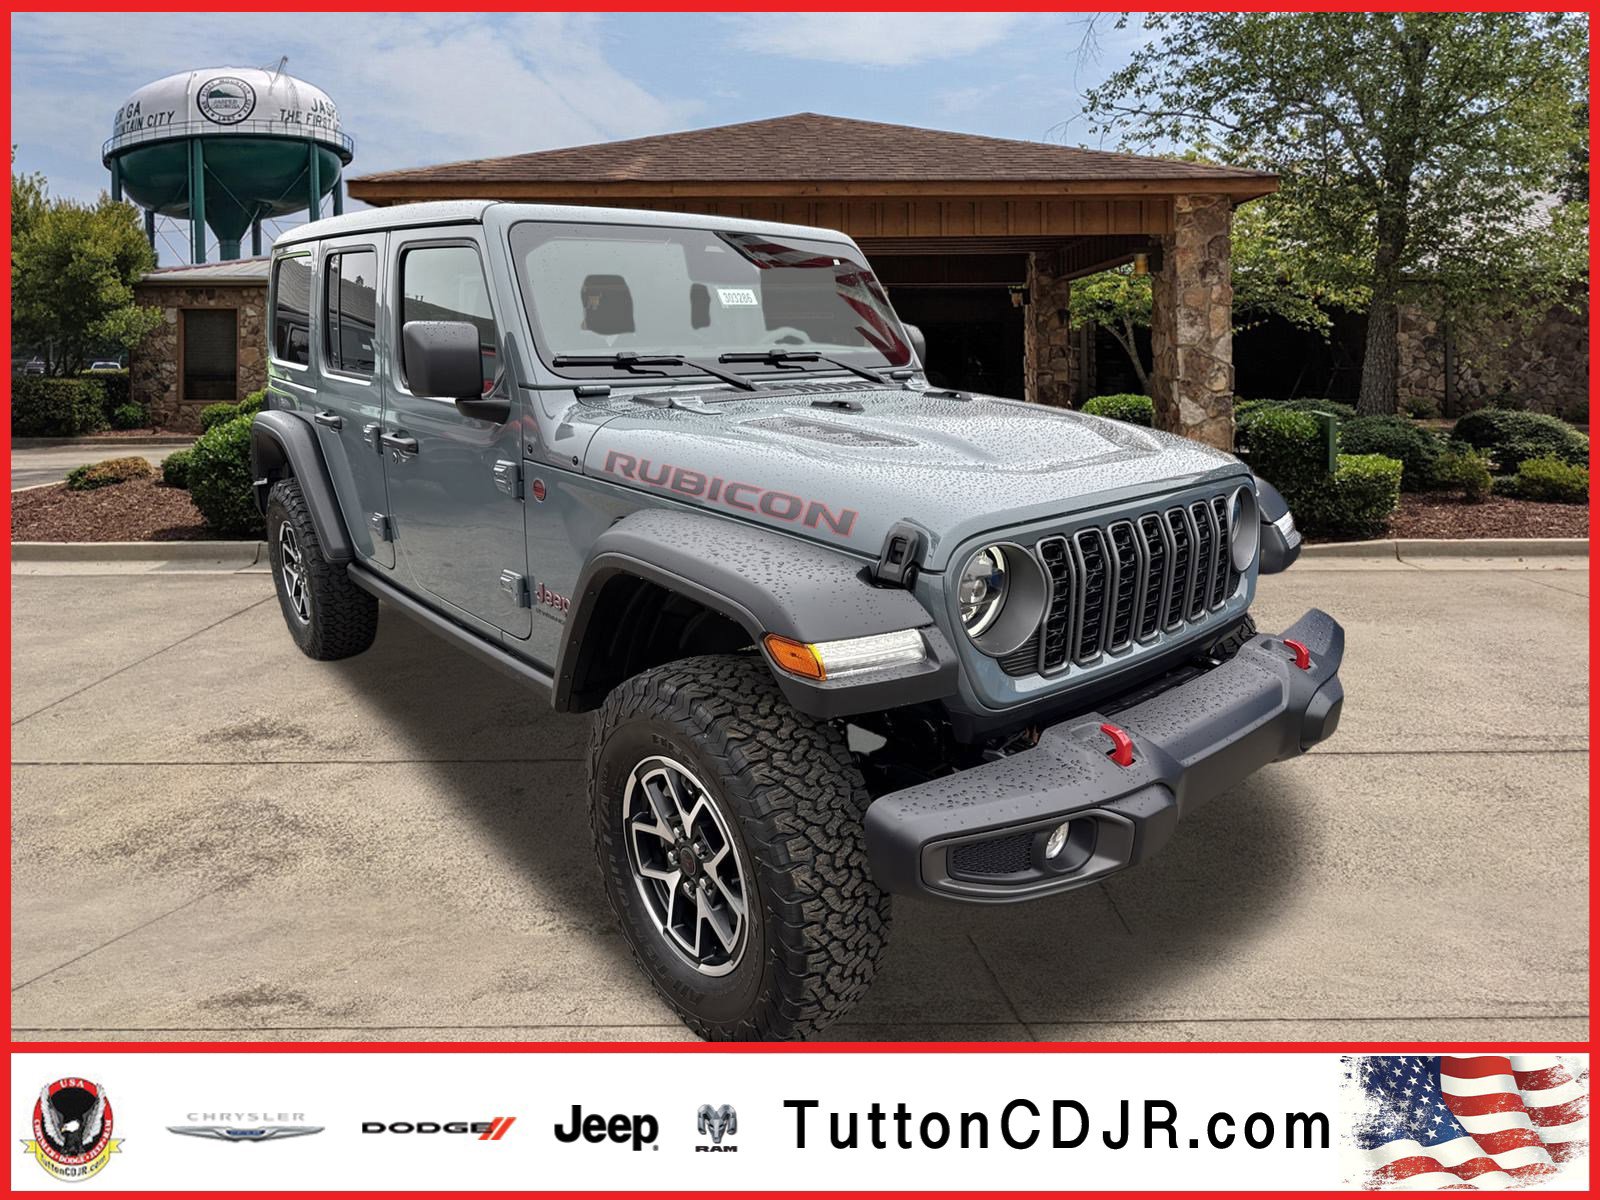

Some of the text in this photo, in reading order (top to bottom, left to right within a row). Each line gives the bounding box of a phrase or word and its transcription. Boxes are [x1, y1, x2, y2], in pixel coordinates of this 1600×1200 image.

[126, 101, 141, 119] GA
[147, 111, 175, 127] CITY
[280, 108, 302, 124] THE
[604, 450, 858, 537] RUBICON
[535, 582, 570, 617] Jeep
